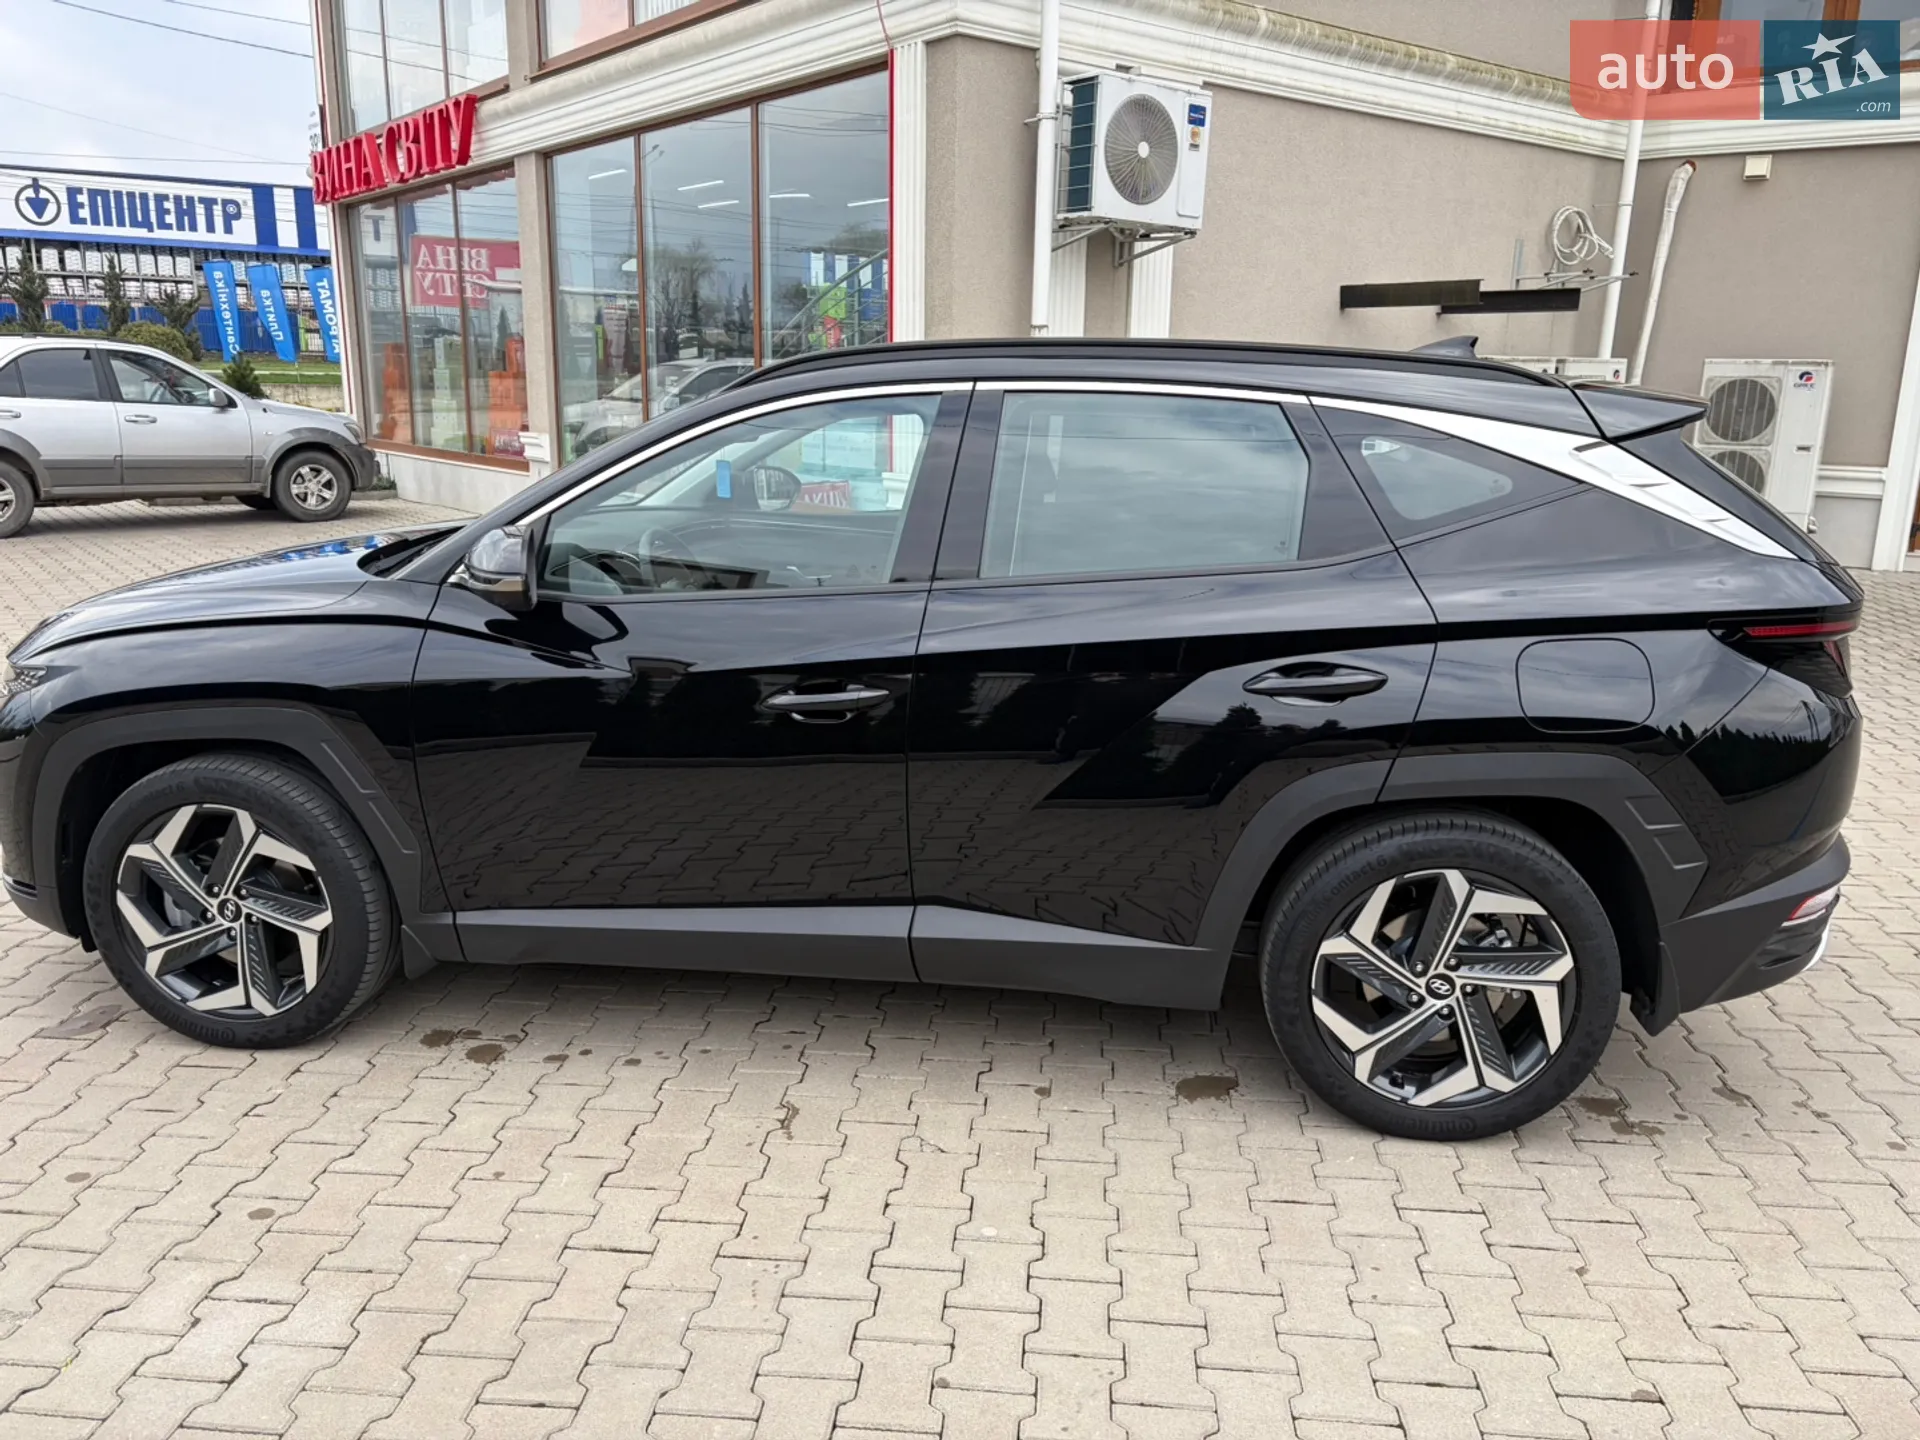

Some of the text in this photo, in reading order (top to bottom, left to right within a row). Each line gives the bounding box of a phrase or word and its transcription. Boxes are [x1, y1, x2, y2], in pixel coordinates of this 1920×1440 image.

[311, 132, 387, 204] ВИНА
[382, 94, 479, 184] СВІТУ
[66, 186, 242, 235] ЕПІЦЕНТР
